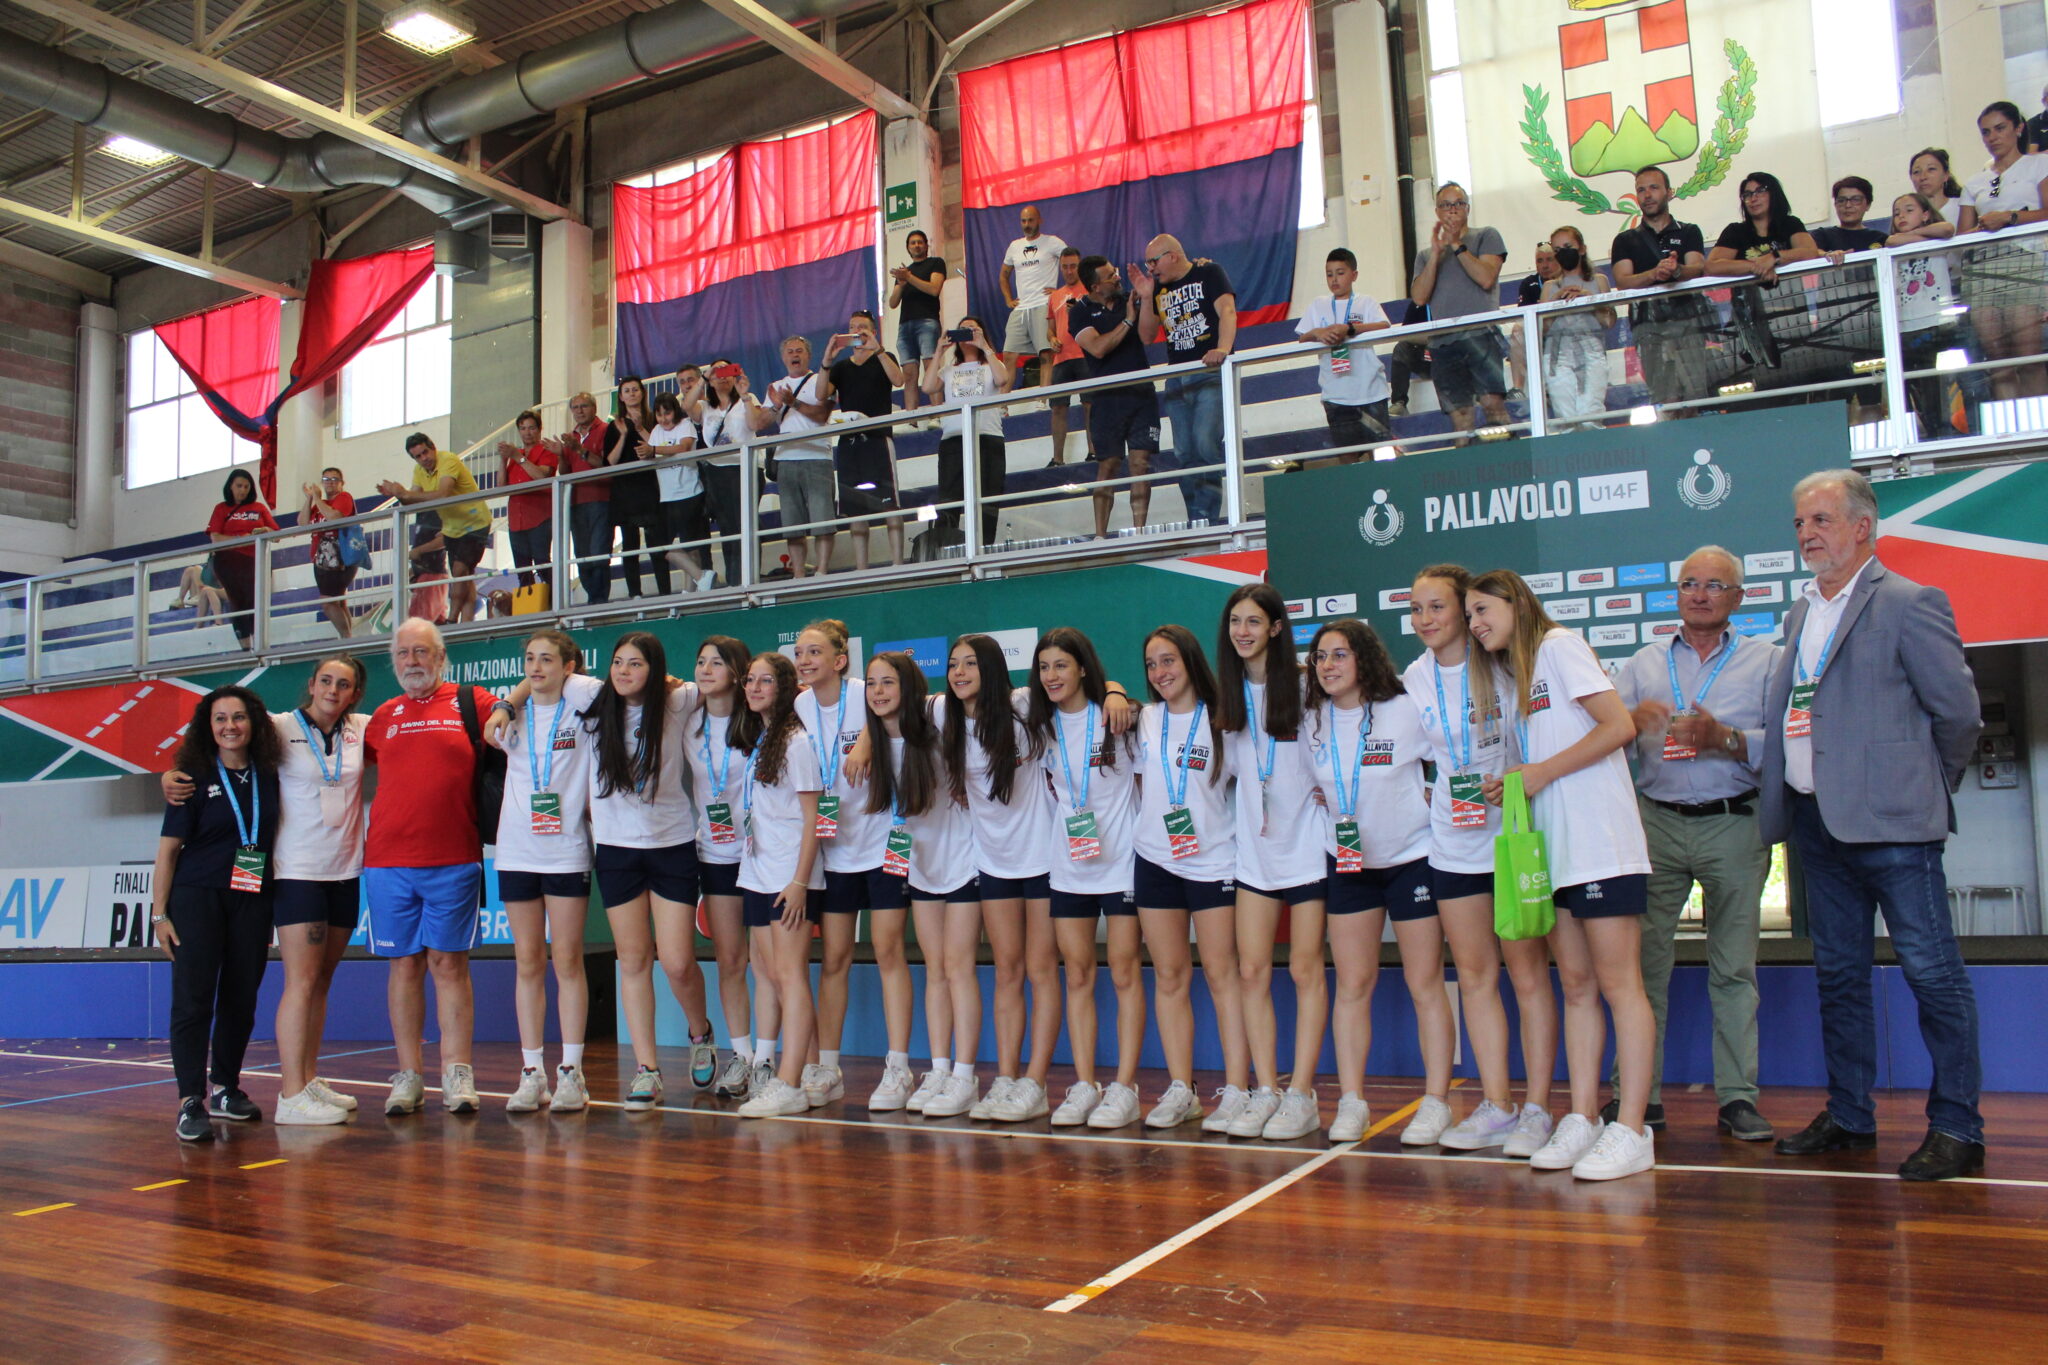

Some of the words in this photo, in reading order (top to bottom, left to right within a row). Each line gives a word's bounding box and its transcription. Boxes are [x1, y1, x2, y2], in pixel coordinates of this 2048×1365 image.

[1160, 282, 1205, 312] BOXEUR
[1167, 306, 1182, 319] DES
[1424, 480, 1572, 533] PALLAVOLO
[1588, 482, 1639, 502] U14F
[778, 631, 795, 643] TITLE
[464, 656, 525, 683] NAZIONAL
[401, 720, 425, 728] SAVINO
[1364, 742, 1394, 752] ALLAVOLO
[1362, 754, 1392, 766] CRAI
[114, 872, 150, 895] FINALI
[0, 878, 65, 940] AV
